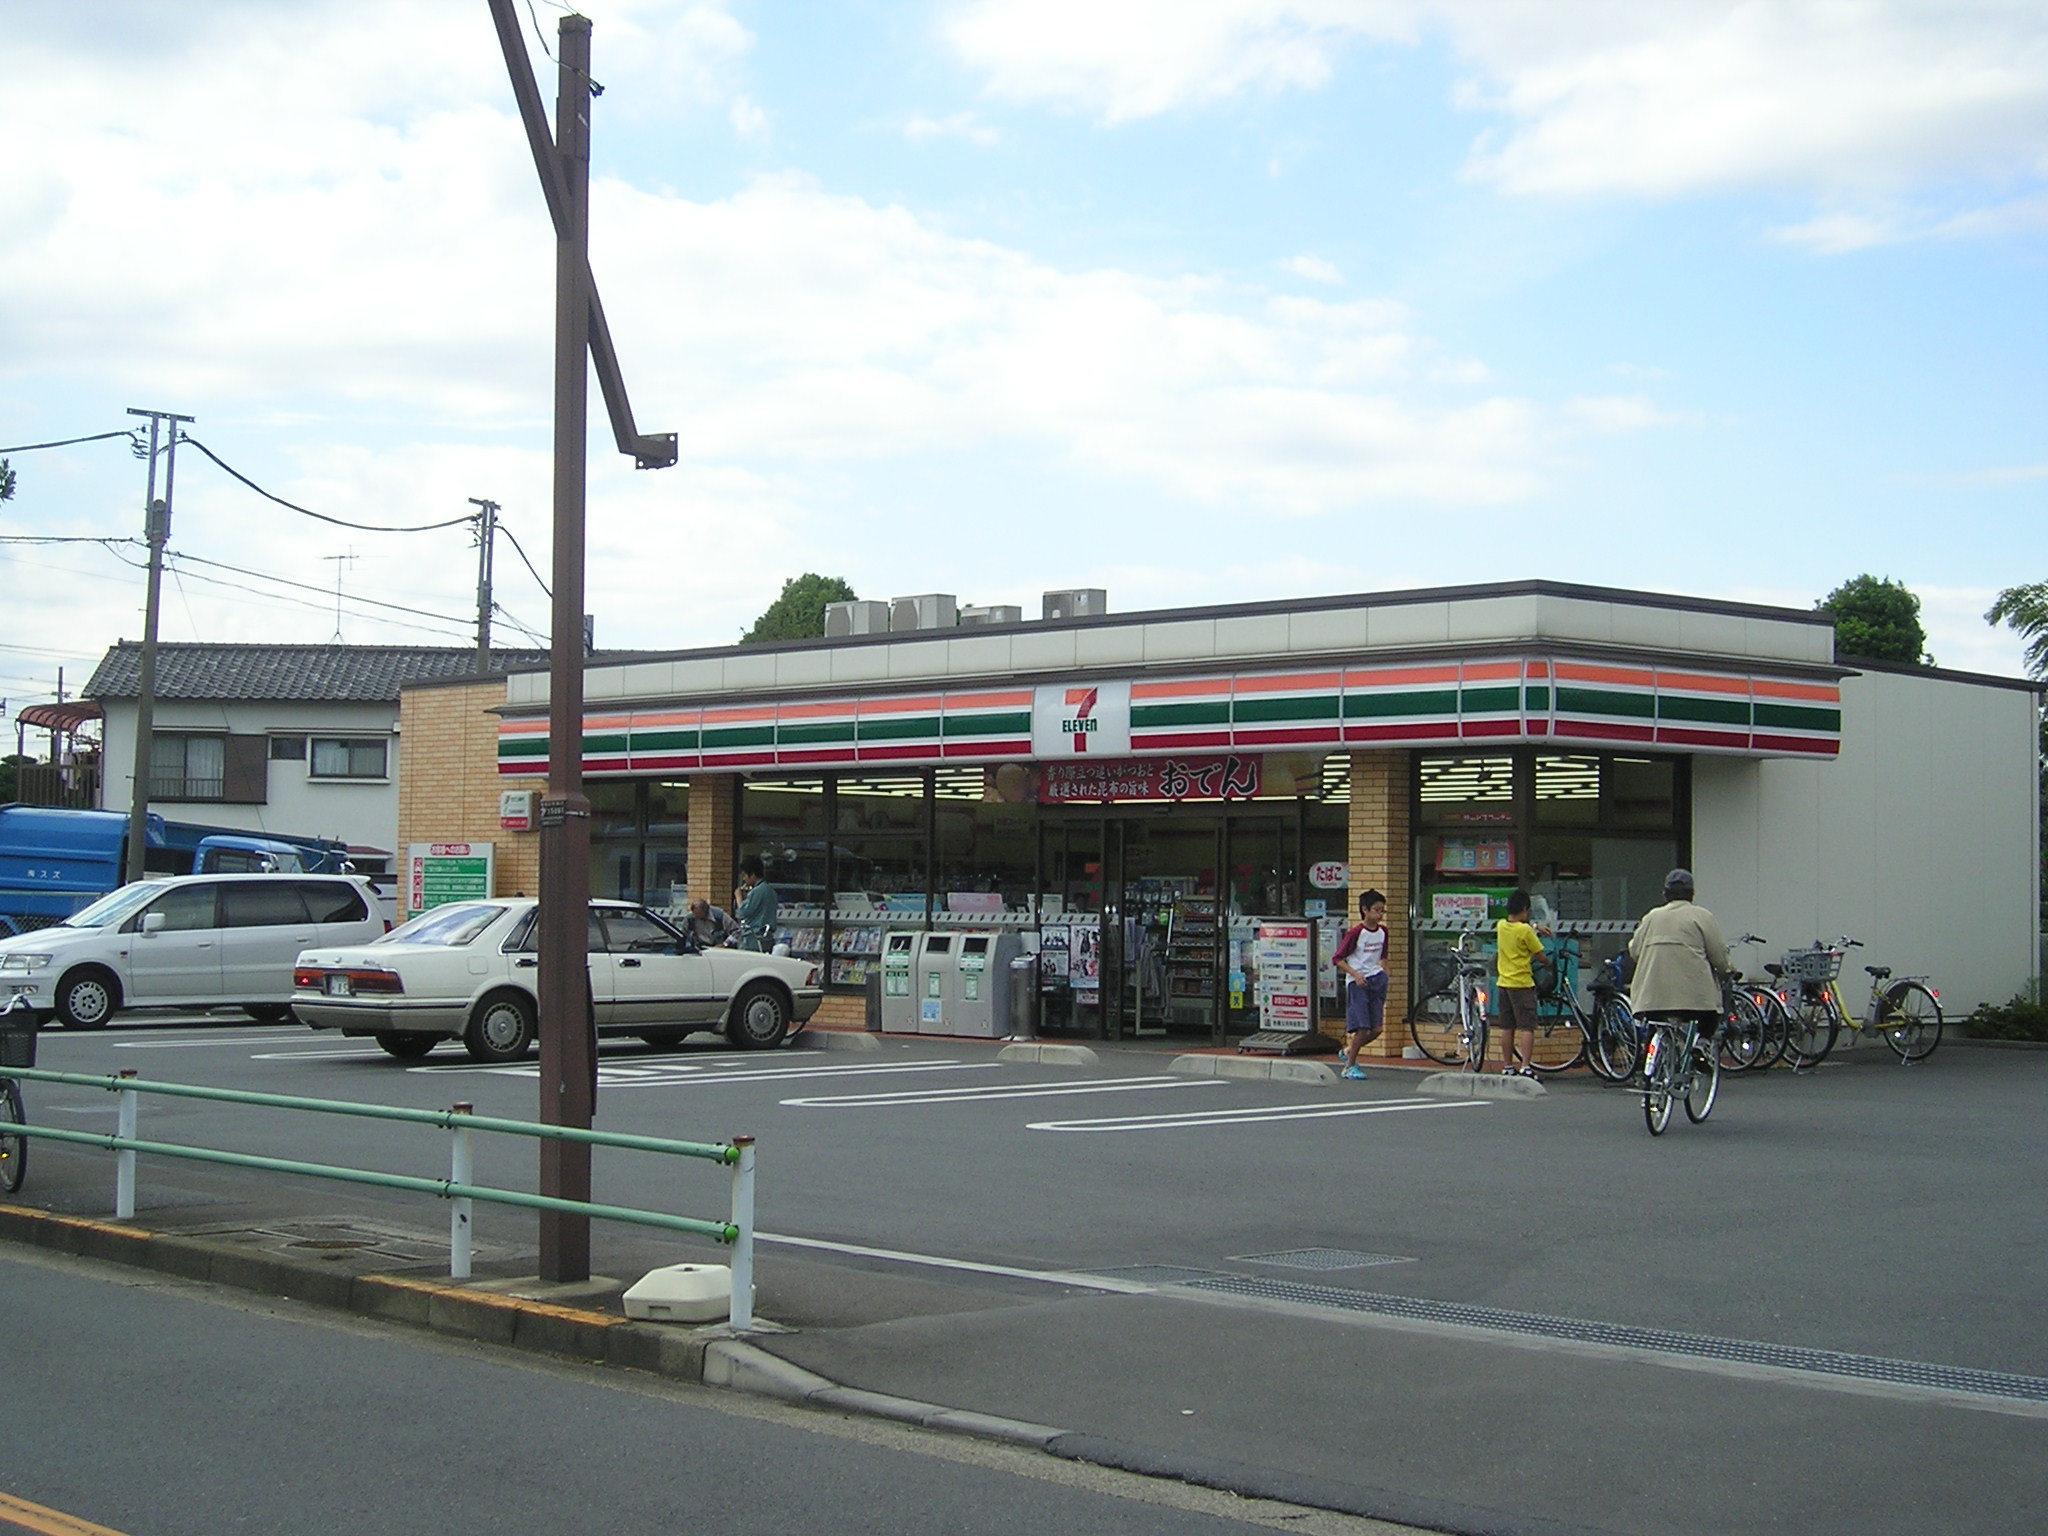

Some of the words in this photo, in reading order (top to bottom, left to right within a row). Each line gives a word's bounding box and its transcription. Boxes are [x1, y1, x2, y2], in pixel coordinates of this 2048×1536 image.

[1065, 687, 1098, 752] 7
[1048, 780, 1150, 797] 厳選された昆布の旨味
[1159, 755, 1258, 797] おでん
[1315, 865, 1342, 881] たばこ
